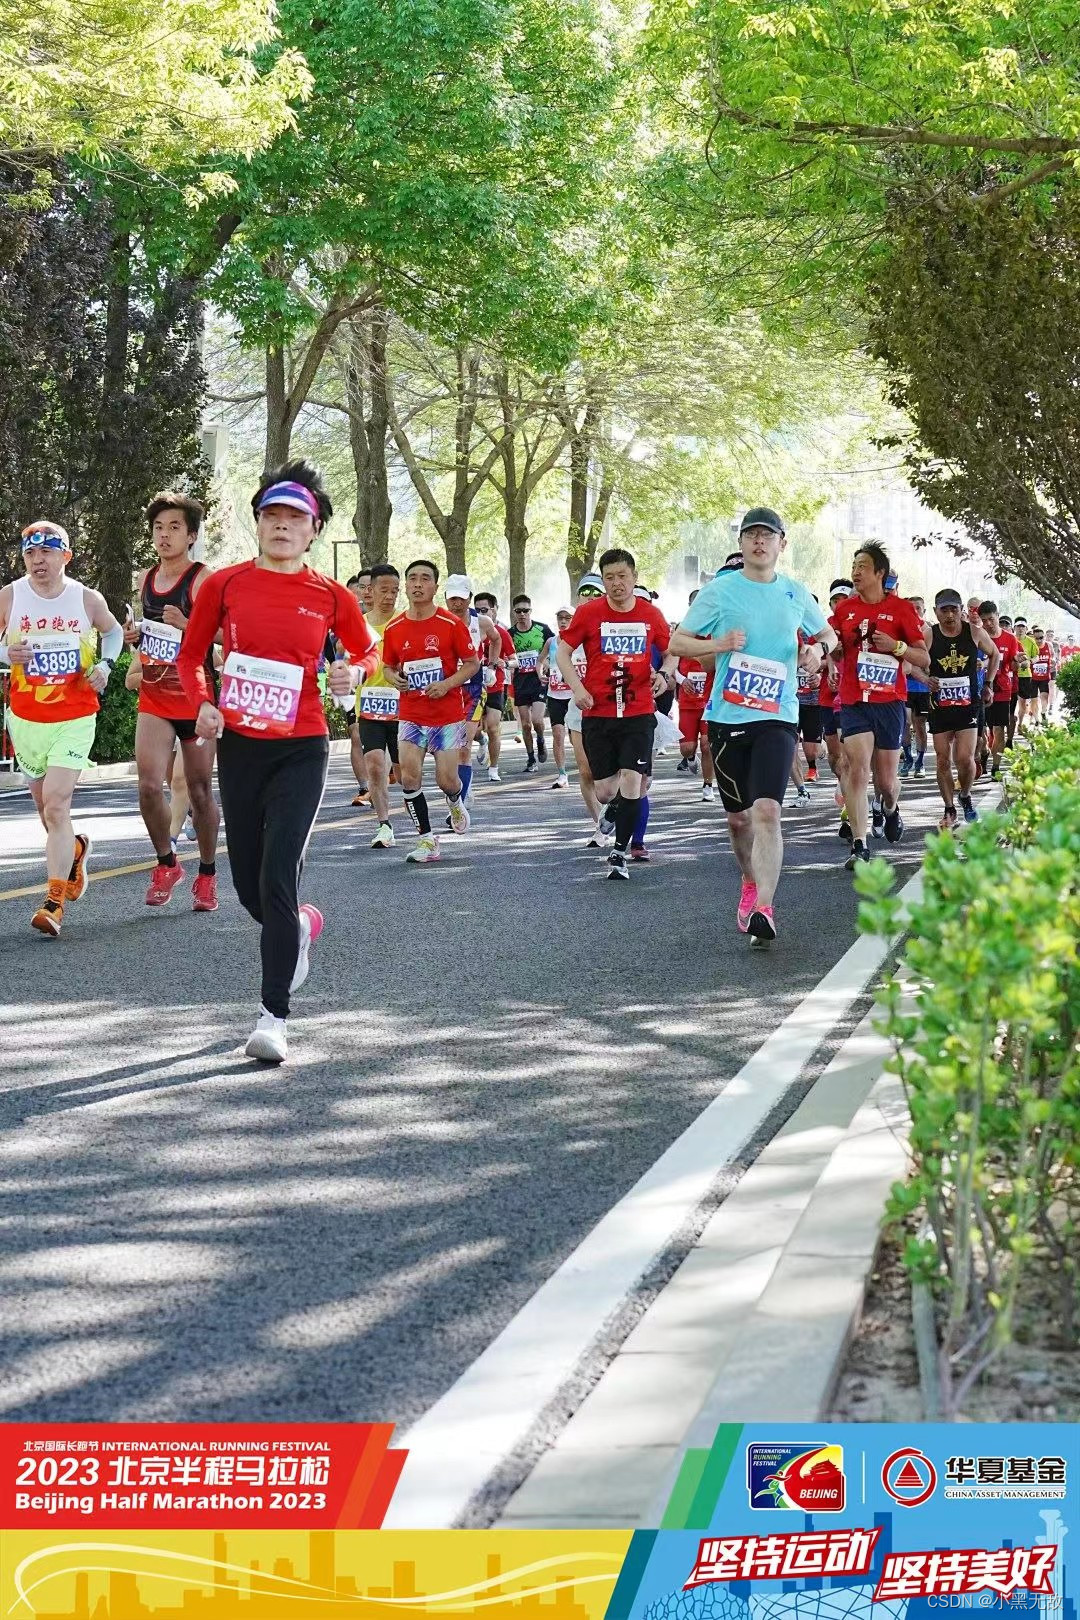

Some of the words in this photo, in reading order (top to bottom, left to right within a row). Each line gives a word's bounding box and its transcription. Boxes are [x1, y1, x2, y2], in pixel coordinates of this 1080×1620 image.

[19, 614, 82, 634] 海口跑吧
[141, 634, 177, 660] A0885
[604, 636, 644, 652] A3217
[27, 650, 78, 673] A3898
[407, 669, 441, 689] A0477
[858, 665, 896, 682] A3777
[728, 670, 780, 698] A1284
[939, 687, 969, 700] A3142
[225, 678, 293, 715] A9959
[362, 698, 398, 713] A5219
